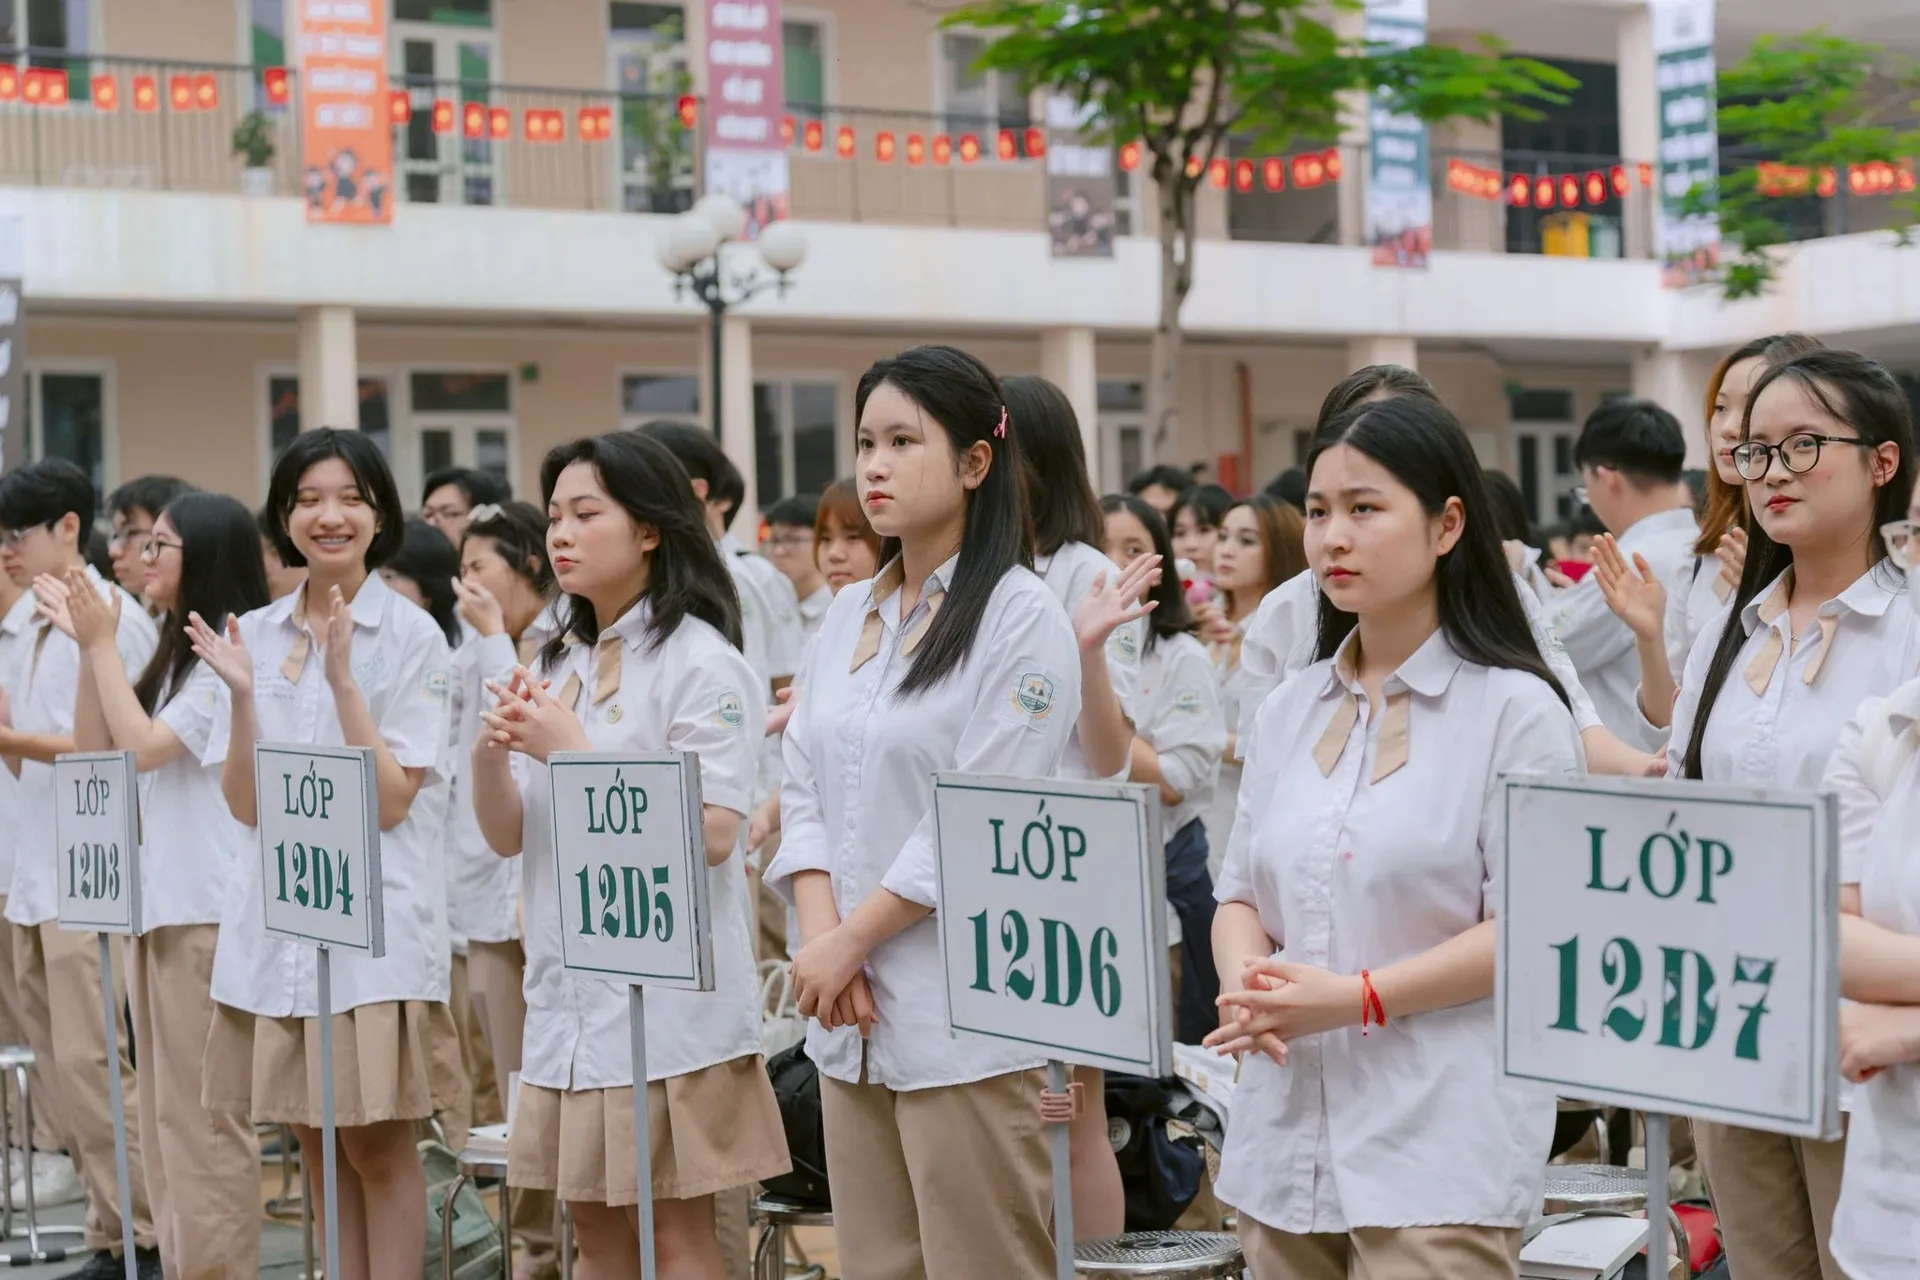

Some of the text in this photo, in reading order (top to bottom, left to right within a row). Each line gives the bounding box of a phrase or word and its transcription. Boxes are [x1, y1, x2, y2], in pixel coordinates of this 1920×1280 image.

[74, 761, 111, 816] LỚP
[283, 760, 335, 820] LỚP
[584, 767, 649, 835] LỚP
[67, 841, 121, 901] 12D3
[274, 840, 355, 917] 12D4
[988, 798, 1087, 883] LỚP
[1584, 811, 1734, 905] LỚP
[575, 862, 675, 944] 12D5
[968, 908, 1123, 1019] 12D6
[1548, 934, 1777, 1063] 12D7
